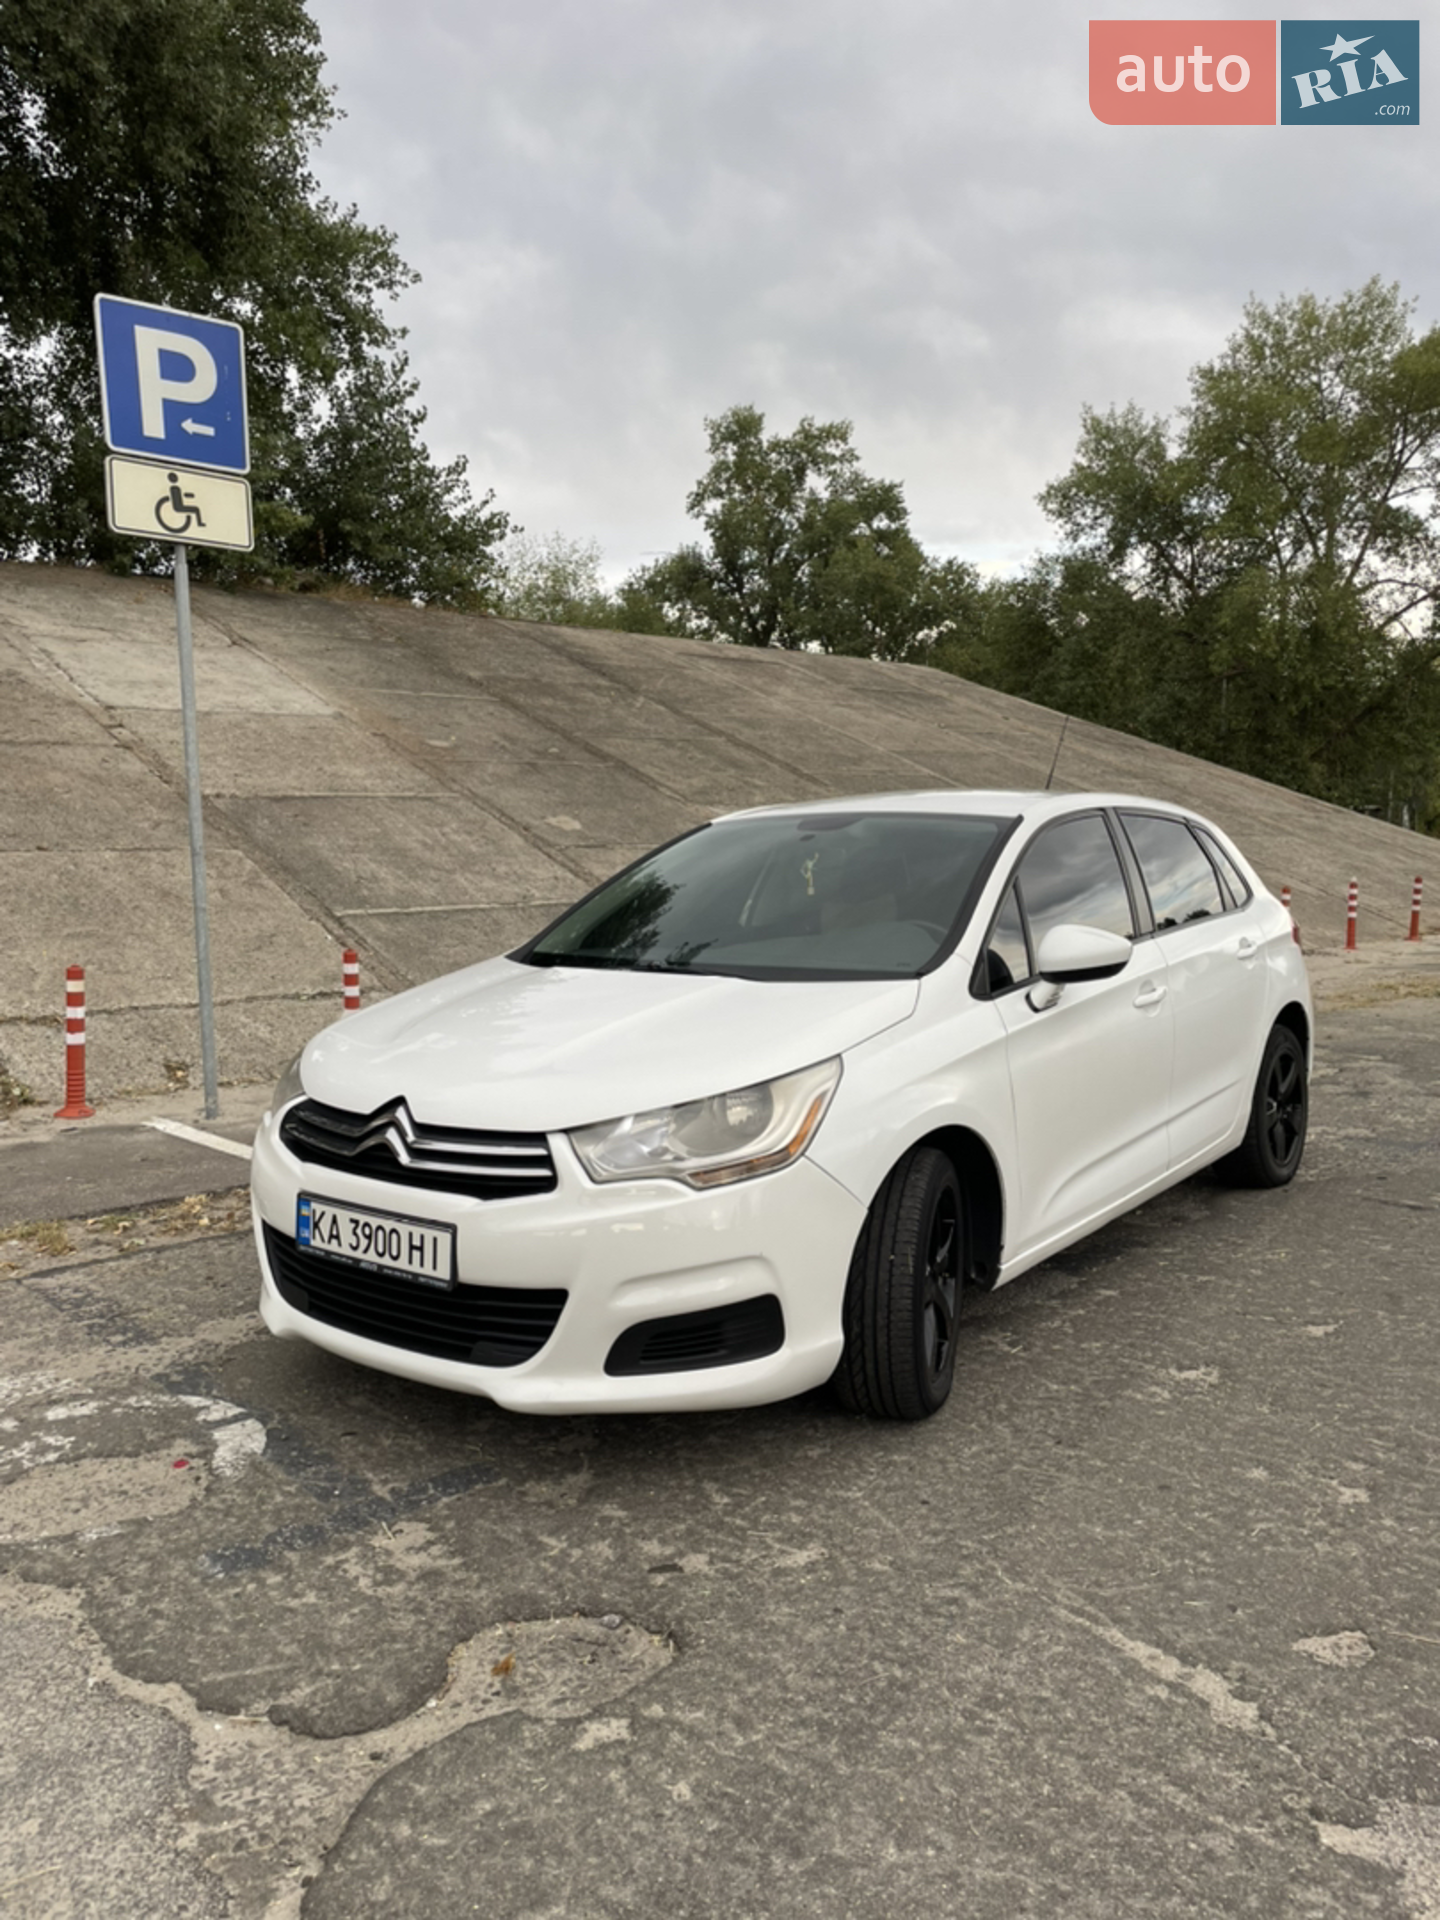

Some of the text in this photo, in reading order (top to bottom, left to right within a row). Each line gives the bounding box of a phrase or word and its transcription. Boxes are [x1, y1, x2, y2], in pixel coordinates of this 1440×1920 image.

[134, 324, 218, 440] P
[312, 1208, 342, 1248] KA
[348, 1217, 401, 1262] 3900
[408, 1231, 437, 1271] HI
